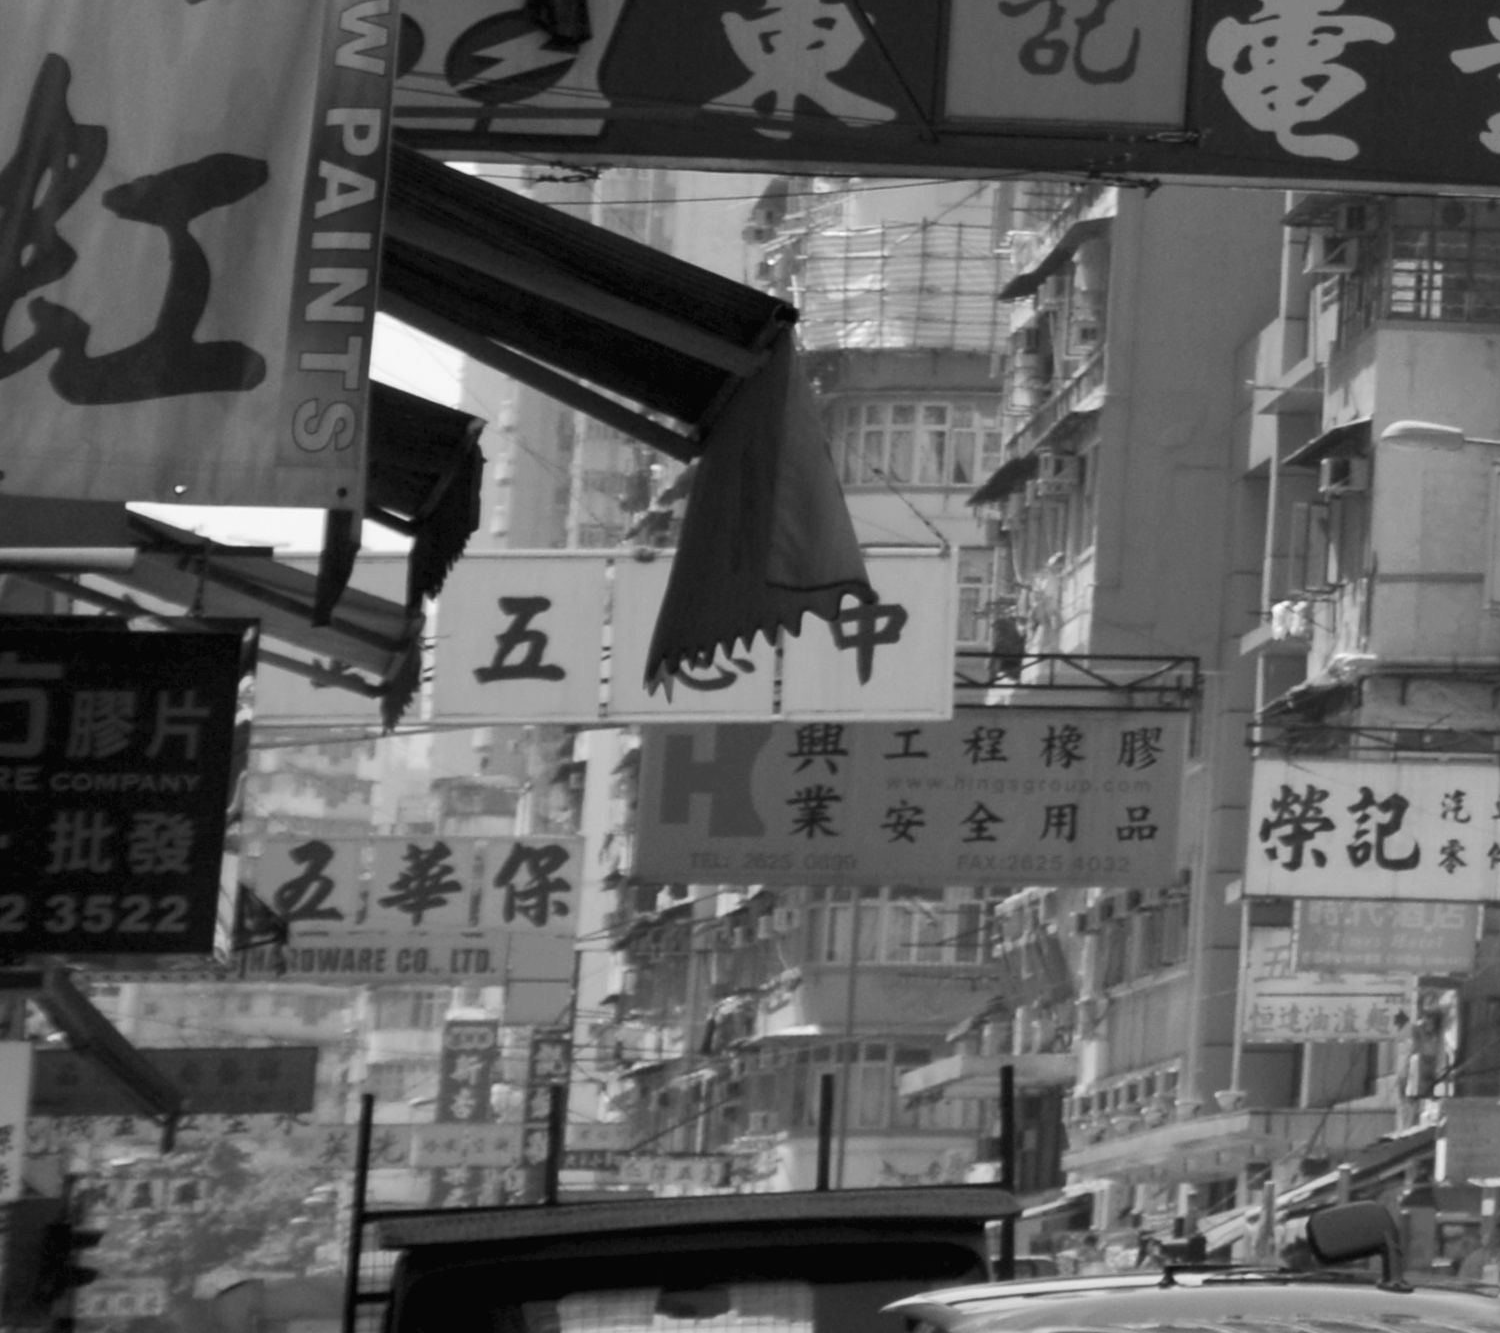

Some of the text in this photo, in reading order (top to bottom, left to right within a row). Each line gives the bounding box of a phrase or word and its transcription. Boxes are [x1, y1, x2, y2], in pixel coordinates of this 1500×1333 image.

[290, 105, 384, 455] PAINTS
[884, 724, 1163, 771] 工程橡膠
[50, 772, 200, 793] COMPANY
[46, 810, 195, 875] 批發
[880, 800, 1160, 845] 安全用品
[1259, 785, 1421, 873] 榮記
[45, 894, 189, 934] 3522
[452, 949, 496, 975] LTD.
